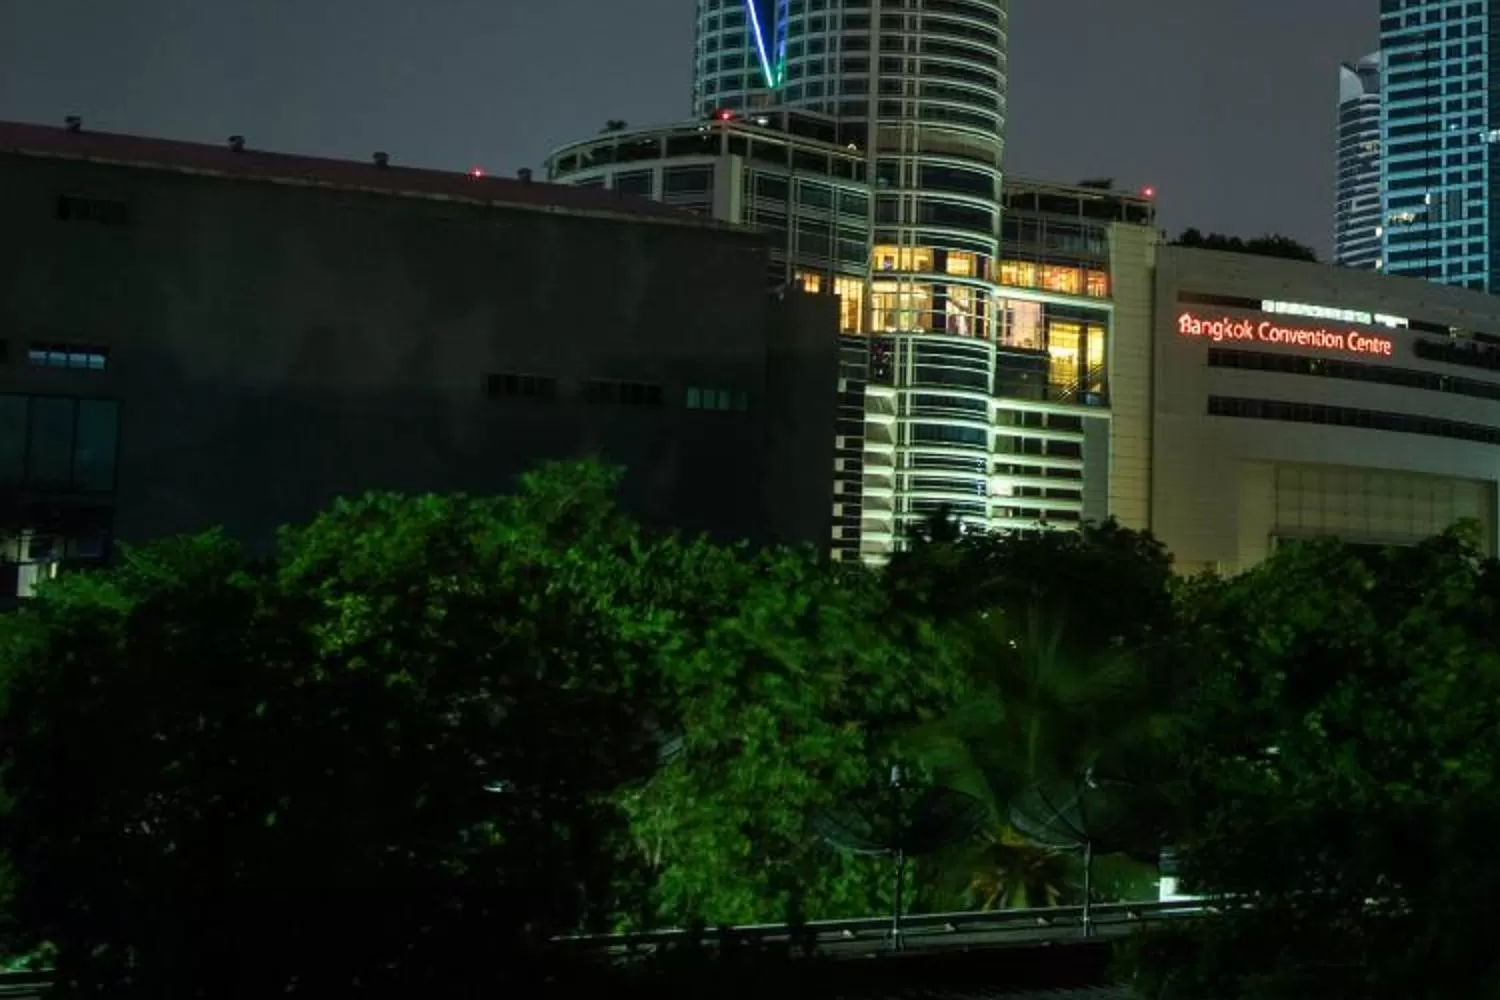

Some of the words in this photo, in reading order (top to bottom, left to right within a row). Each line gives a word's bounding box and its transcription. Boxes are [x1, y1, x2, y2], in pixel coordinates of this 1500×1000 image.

[1178, 313, 1253, 341] Bangkok
[1257, 321, 1344, 348] Convention
[1347, 331, 1391, 354] Centre
